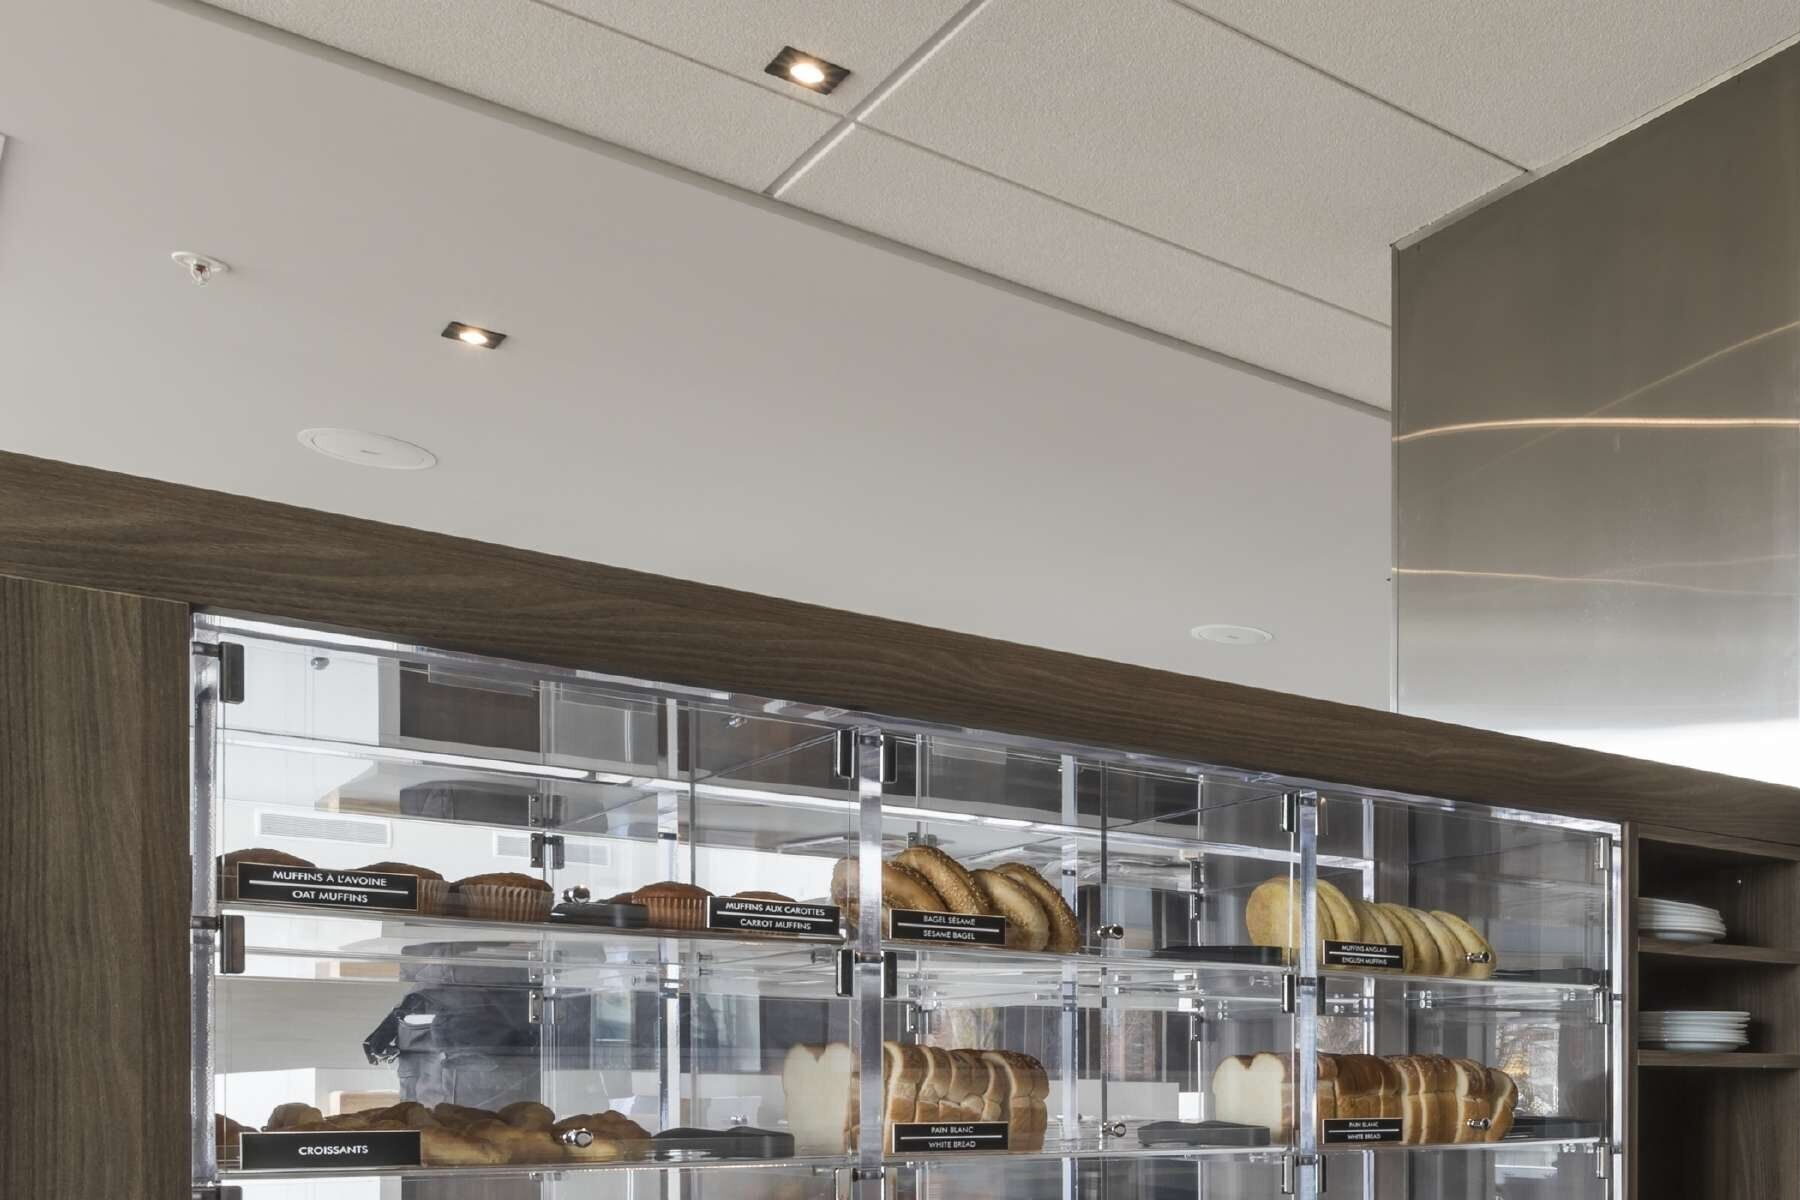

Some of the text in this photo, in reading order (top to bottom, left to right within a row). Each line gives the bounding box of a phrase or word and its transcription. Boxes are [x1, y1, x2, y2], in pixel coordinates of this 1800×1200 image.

[272, 870, 324, 882] MUFFINS
[338, 874, 388, 887] L'AVOINE
[292, 890, 369, 904] OAT MUFFINS
[725, 902, 825, 916] MUFFINS AUX CAROTTES
[740, 919, 811, 930] CARROT MUFFINS
[923, 915, 946, 924] BAGEL
[952, 931, 976, 940] BAGEL
[931, 1125, 974, 1134] PAIN BLANC
[928, 1140, 976, 1149] WHITE BREAD
[298, 1145, 369, 1156] CROISSANTS
